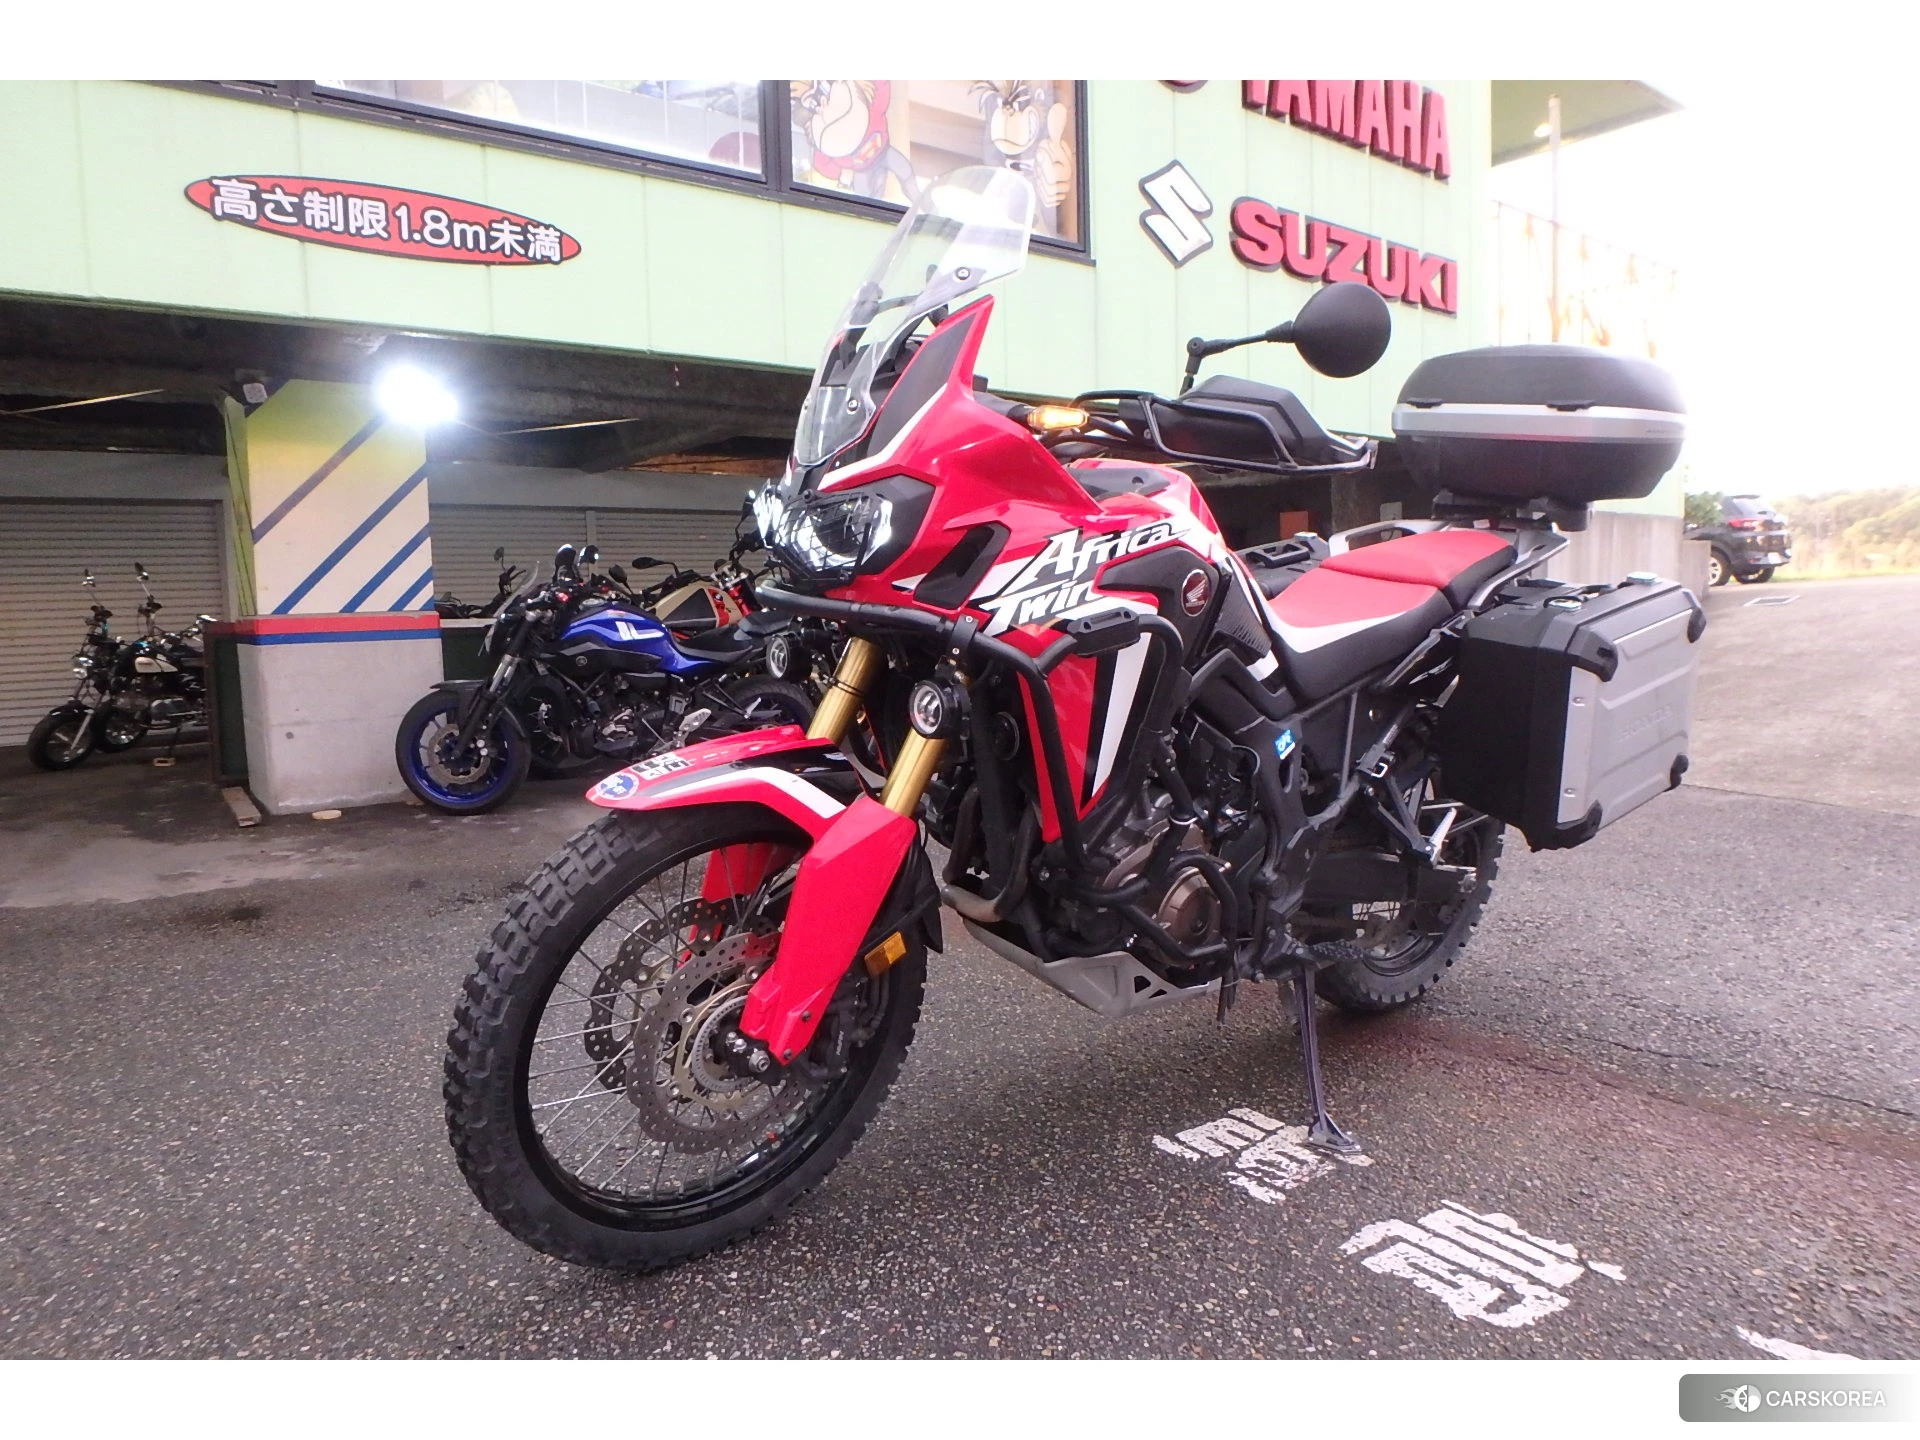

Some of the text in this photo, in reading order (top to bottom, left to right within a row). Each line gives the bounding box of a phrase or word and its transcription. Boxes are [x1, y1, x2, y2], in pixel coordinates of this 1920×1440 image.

[212, 178, 561, 262] 高さ制限1.8m未満
[1231, 199, 1458, 315] SUZUKI
[1003, 528, 1192, 594] Africa
[979, 578, 1104, 637] Twin
